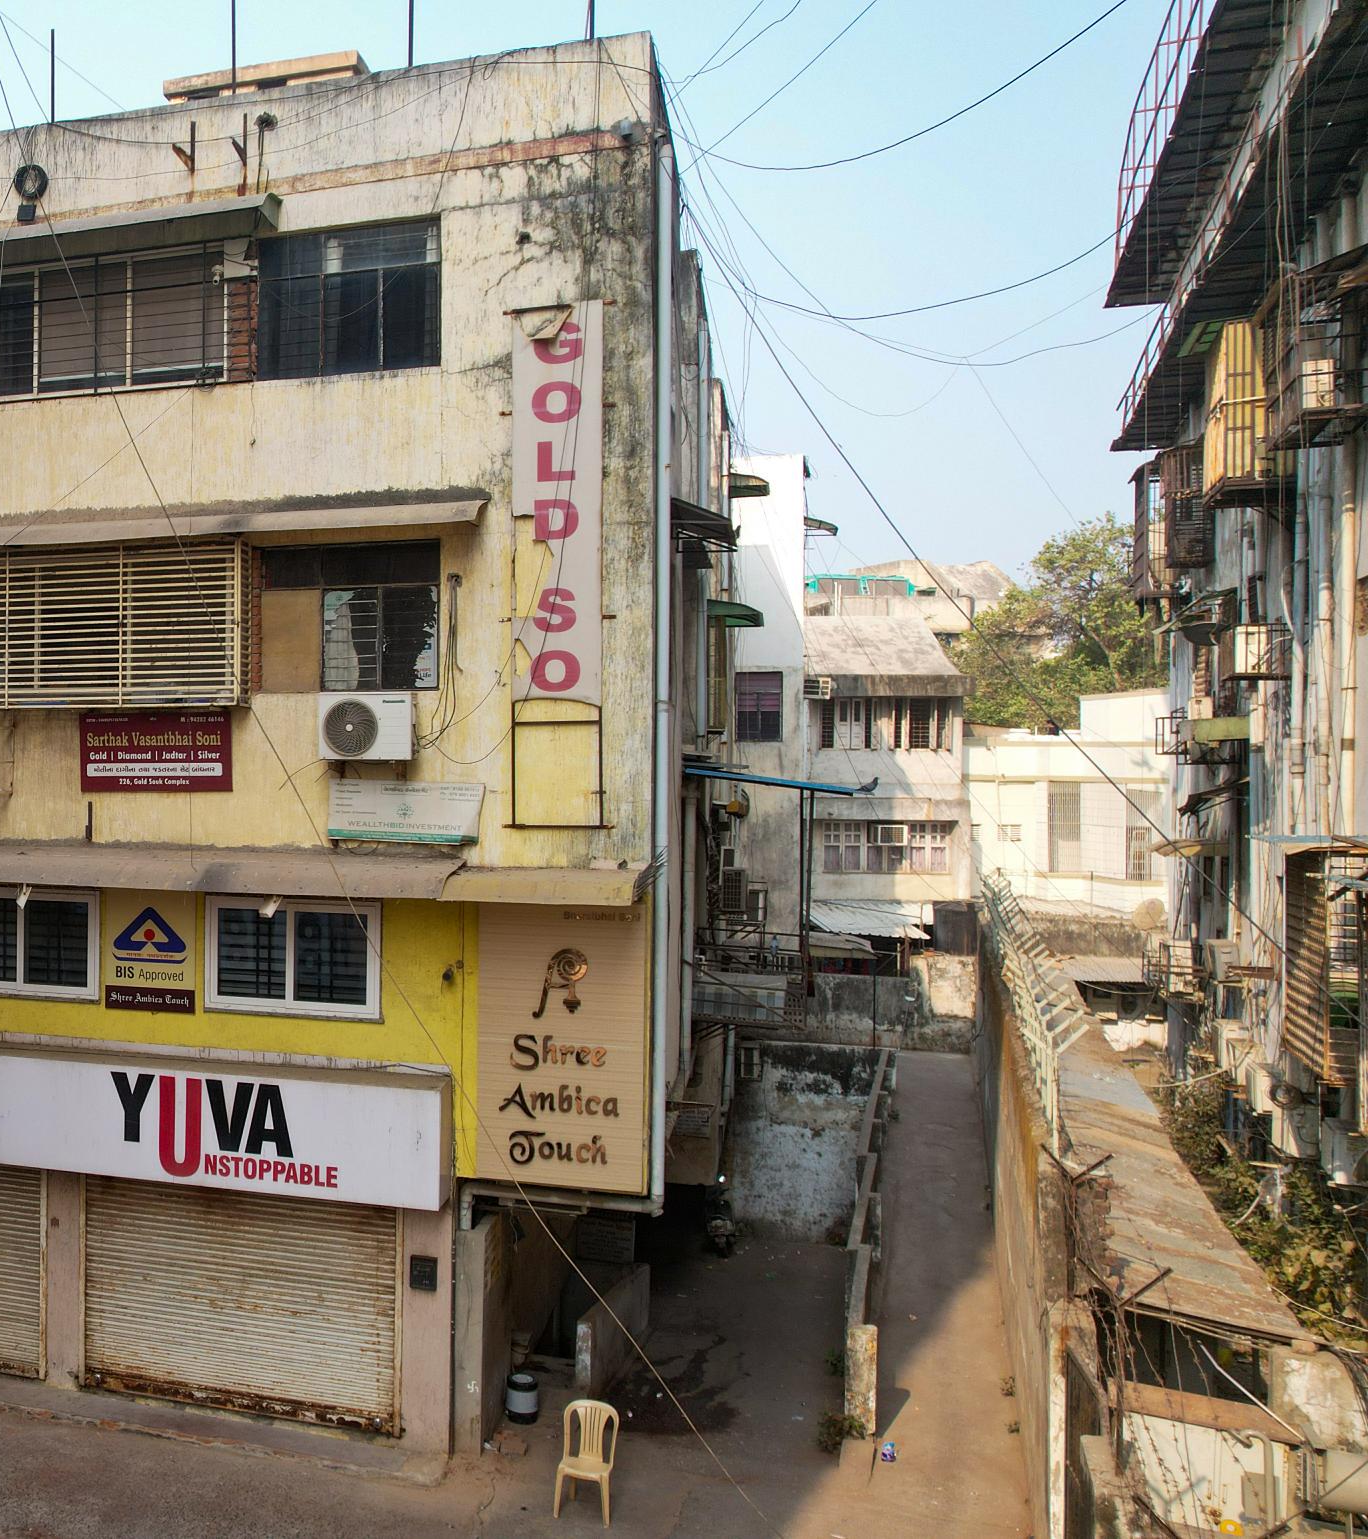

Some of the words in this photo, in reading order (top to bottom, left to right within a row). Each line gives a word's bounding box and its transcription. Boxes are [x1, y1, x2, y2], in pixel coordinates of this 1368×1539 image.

[531, 319, 583, 541] GOLD
[530, 587, 582, 693] SO
[86, 732, 129, 747] Sarthak
[132, 730, 193, 747] Vasantbhai
[196, 730, 222, 746] Soni
[89, 751, 107, 760] Gold
[117, 751, 152, 760] Diamond
[162, 750, 187, 761] Jadtar
[198, 750, 221, 760] Silver
[119, 778, 133, 786] 226,
[164, 778, 190, 786] Complex
[115, 965, 134, 979] BIS
[139, 968, 184, 982] Approved
[109, 991, 133, 1003] Shree
[134, 992, 163, 1004] Ambica
[509, 1034, 608, 1071] Shree
[498, 1082, 620, 1120] Ambica
[110, 1070, 294, 1177] YUVA
[508, 1129, 608, 1166] Touch
